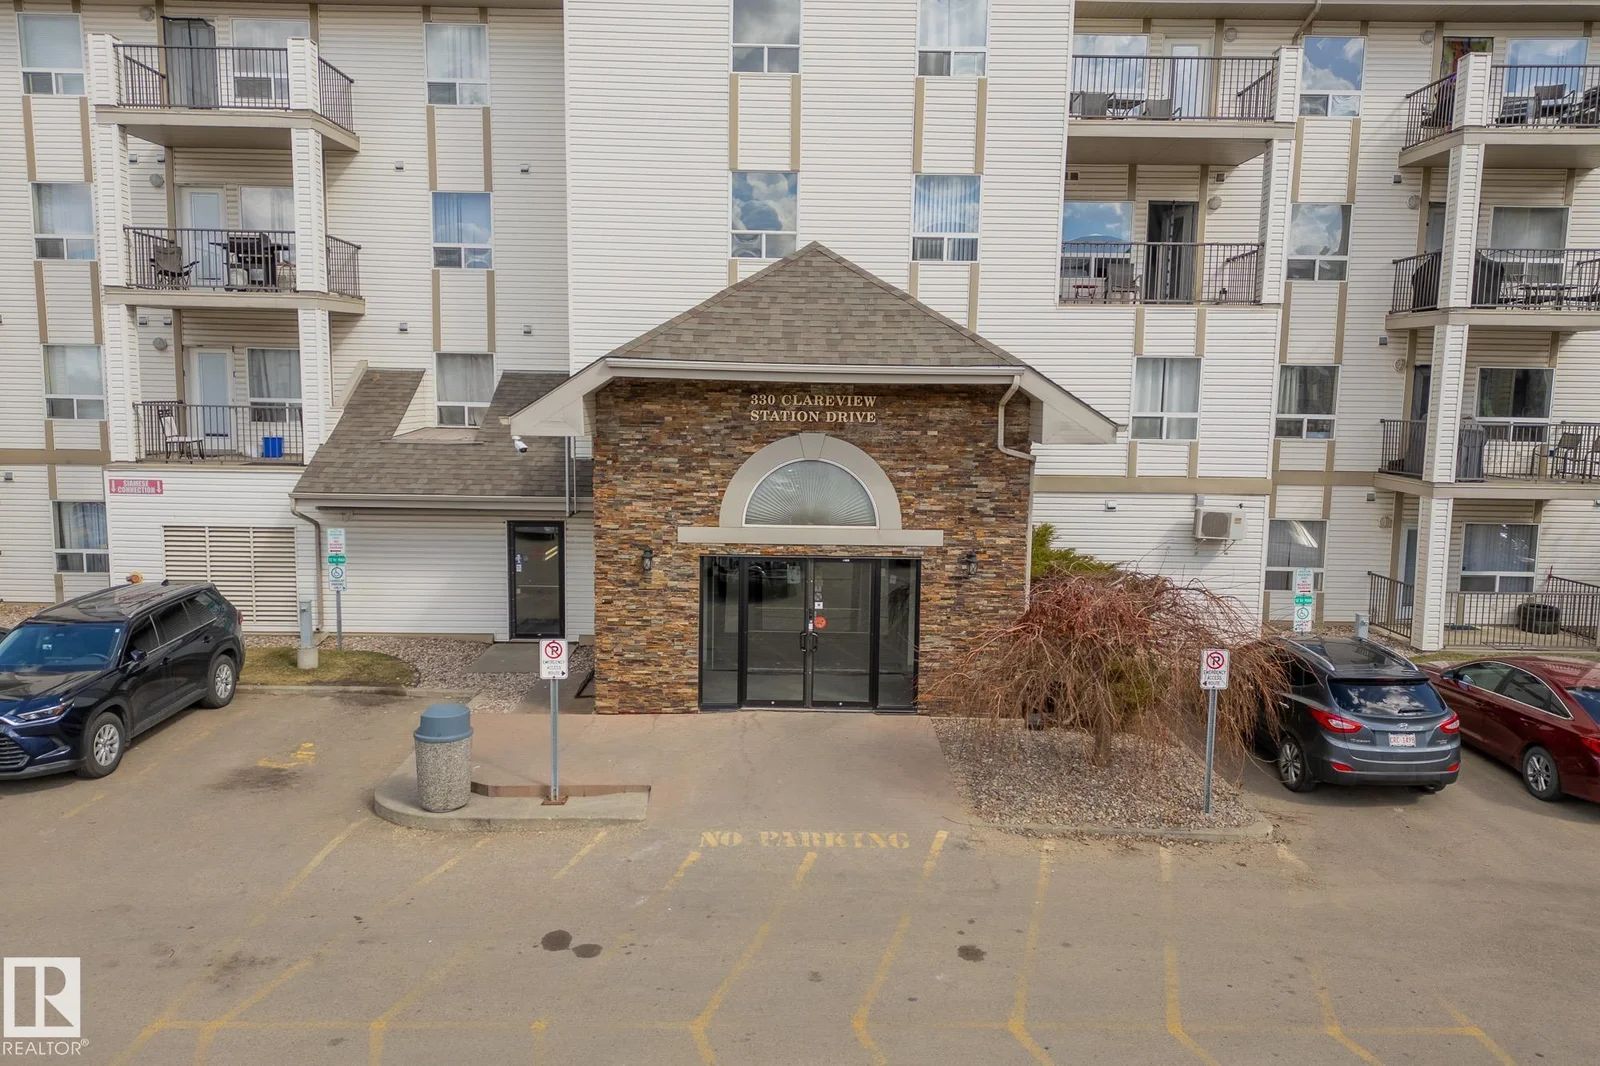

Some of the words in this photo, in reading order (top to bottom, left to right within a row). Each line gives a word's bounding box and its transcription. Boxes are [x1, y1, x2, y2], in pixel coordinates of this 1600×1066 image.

[750, 394, 776, 406] 330
[781, 395, 877, 407] CLAREVIEW
[750, 410, 820, 422] STATION
[826, 411, 877, 423] DRIVE
[117, 486, 156, 494] CONNECTION
[700, 831, 743, 848] NO
[758, 831, 910, 849] PARKING
